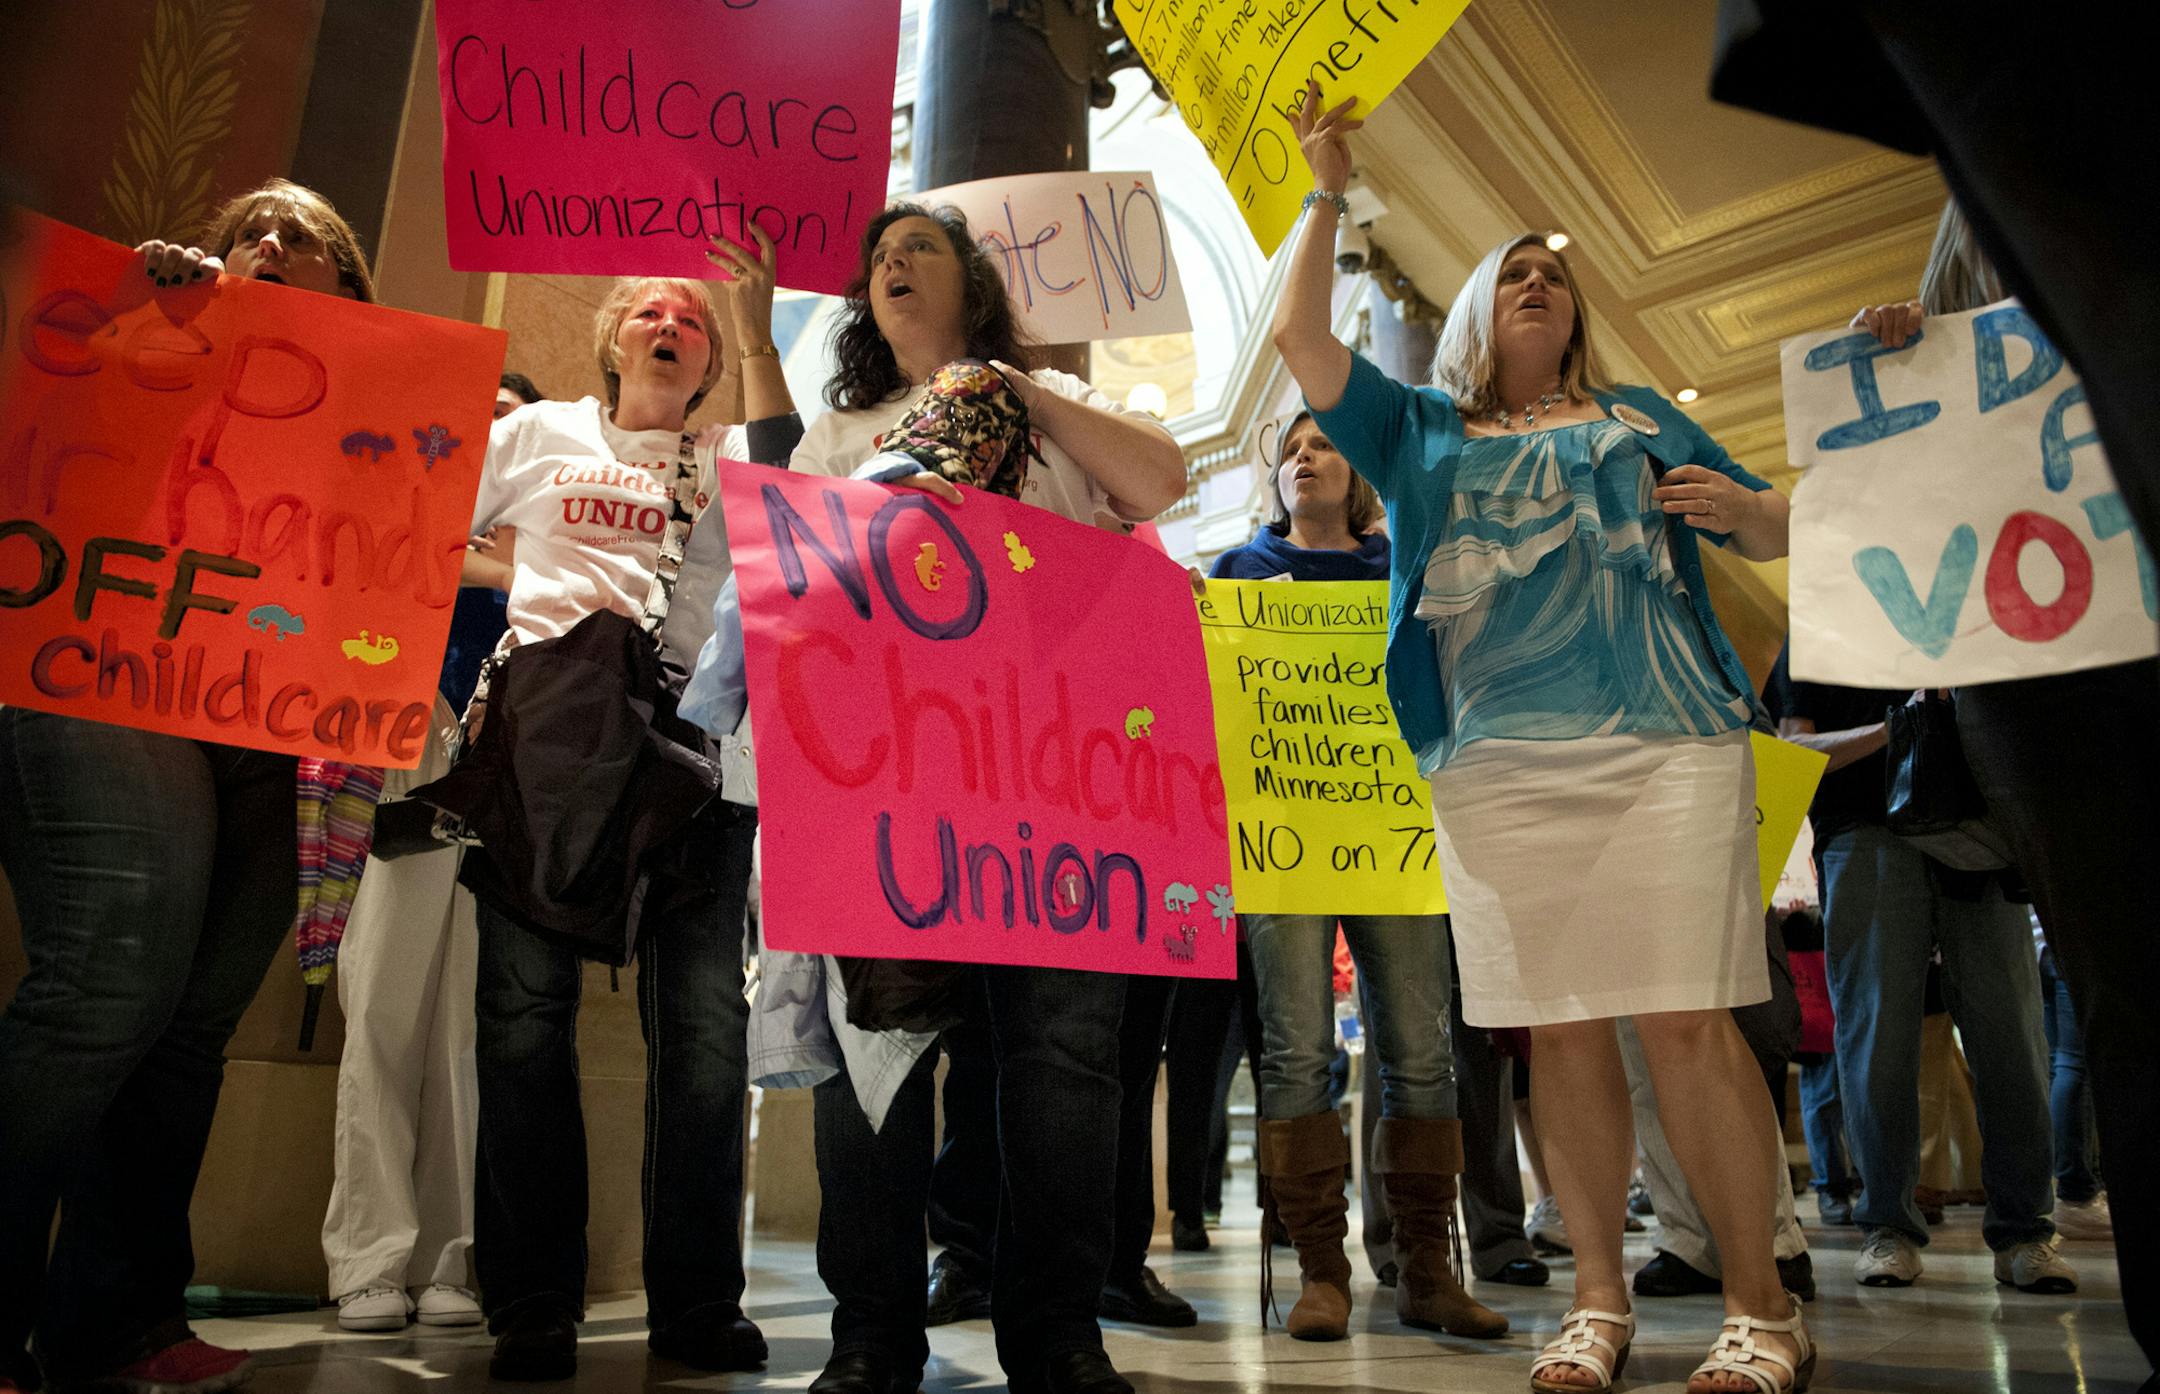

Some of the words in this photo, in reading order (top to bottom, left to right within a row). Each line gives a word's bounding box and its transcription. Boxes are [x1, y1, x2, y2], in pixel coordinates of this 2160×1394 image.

[1258, 0, 1306, 48] take
[451, 35, 858, 161] Childcare
[470, 170, 854, 258] Unionization!
[1076, 180, 1168, 331] NO
[18, 288, 328, 466] eep
[1804, 328, 1941, 452] I
[553, 463, 709, 510] Childcae
[562, 497, 697, 543] UNIO
[0, 519, 262, 641] OFF
[760, 484, 988, 641] NO
[1237, 586, 1389, 628] Unionizati
[1852, 490, 2159, 660] VOT
[31, 628, 432, 762] childcare
[1237, 652, 1387, 692] provider
[1252, 687, 1390, 726] families
[776, 629, 1227, 840] Childcare
[1254, 765, 1425, 810] Minnesota
[875, 810, 1147, 945] Union
[1238, 820, 1304, 873] NO
[1332, 843, 1377, 873] on
